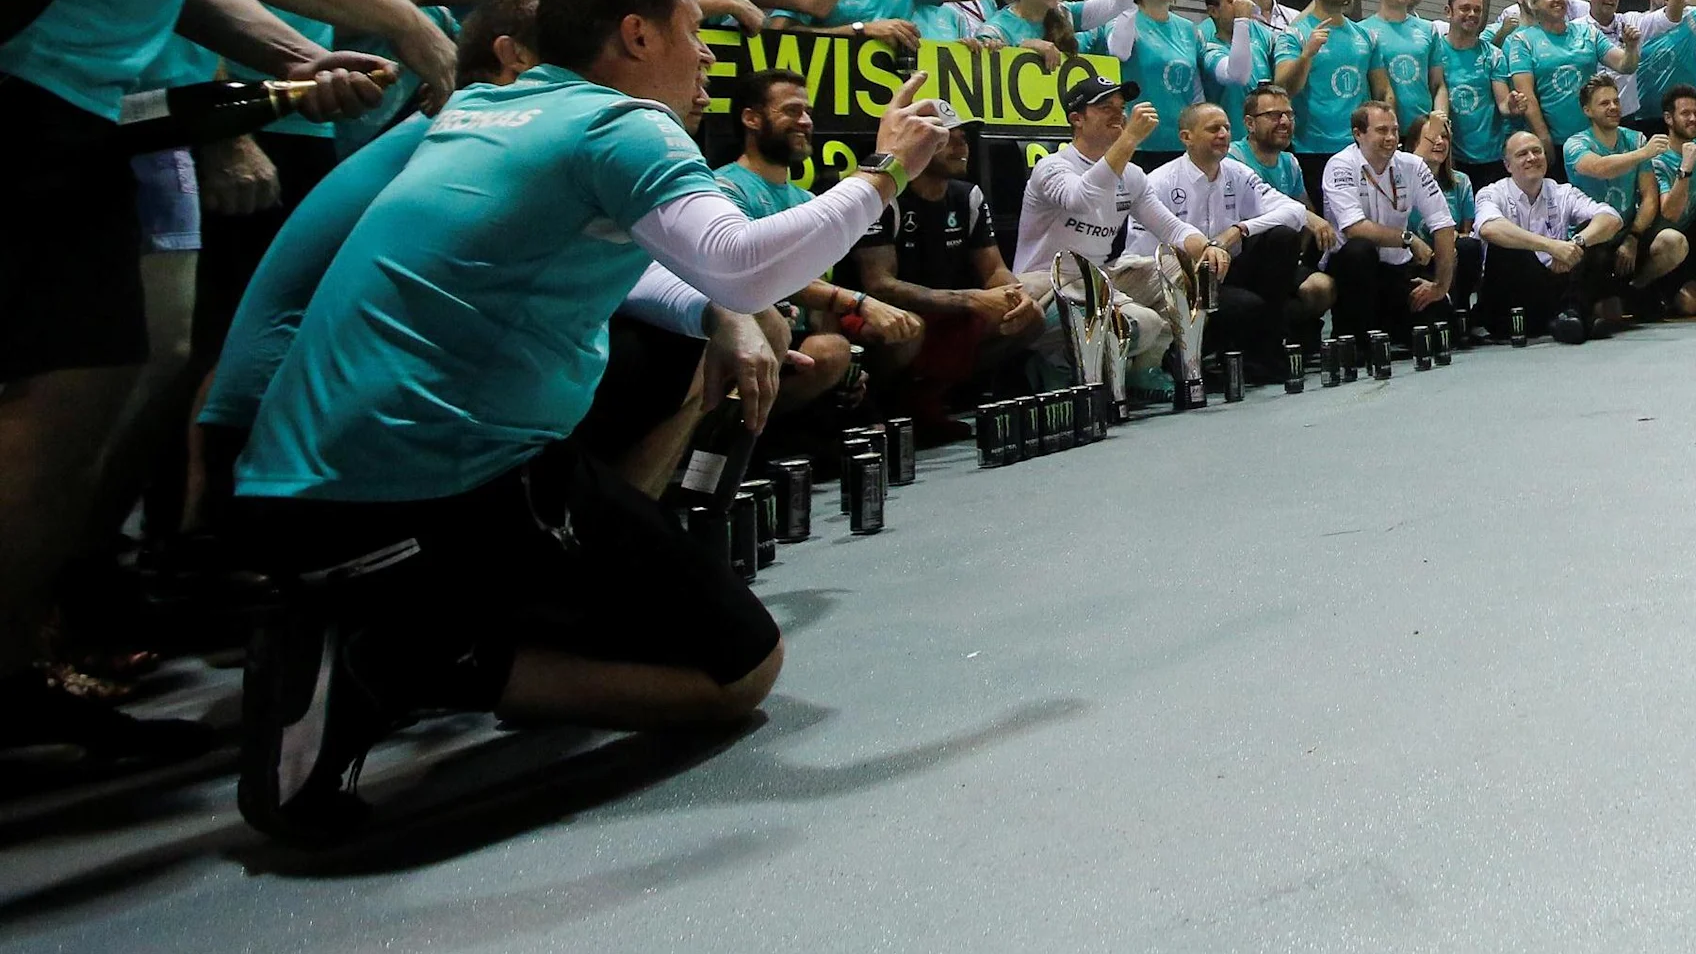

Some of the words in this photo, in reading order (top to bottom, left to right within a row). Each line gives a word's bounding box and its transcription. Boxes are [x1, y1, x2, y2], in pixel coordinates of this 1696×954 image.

[702, 28, 903, 118] EWIS
[936, 45, 1098, 123] NICO
[1064, 217, 1118, 238] PETRON
